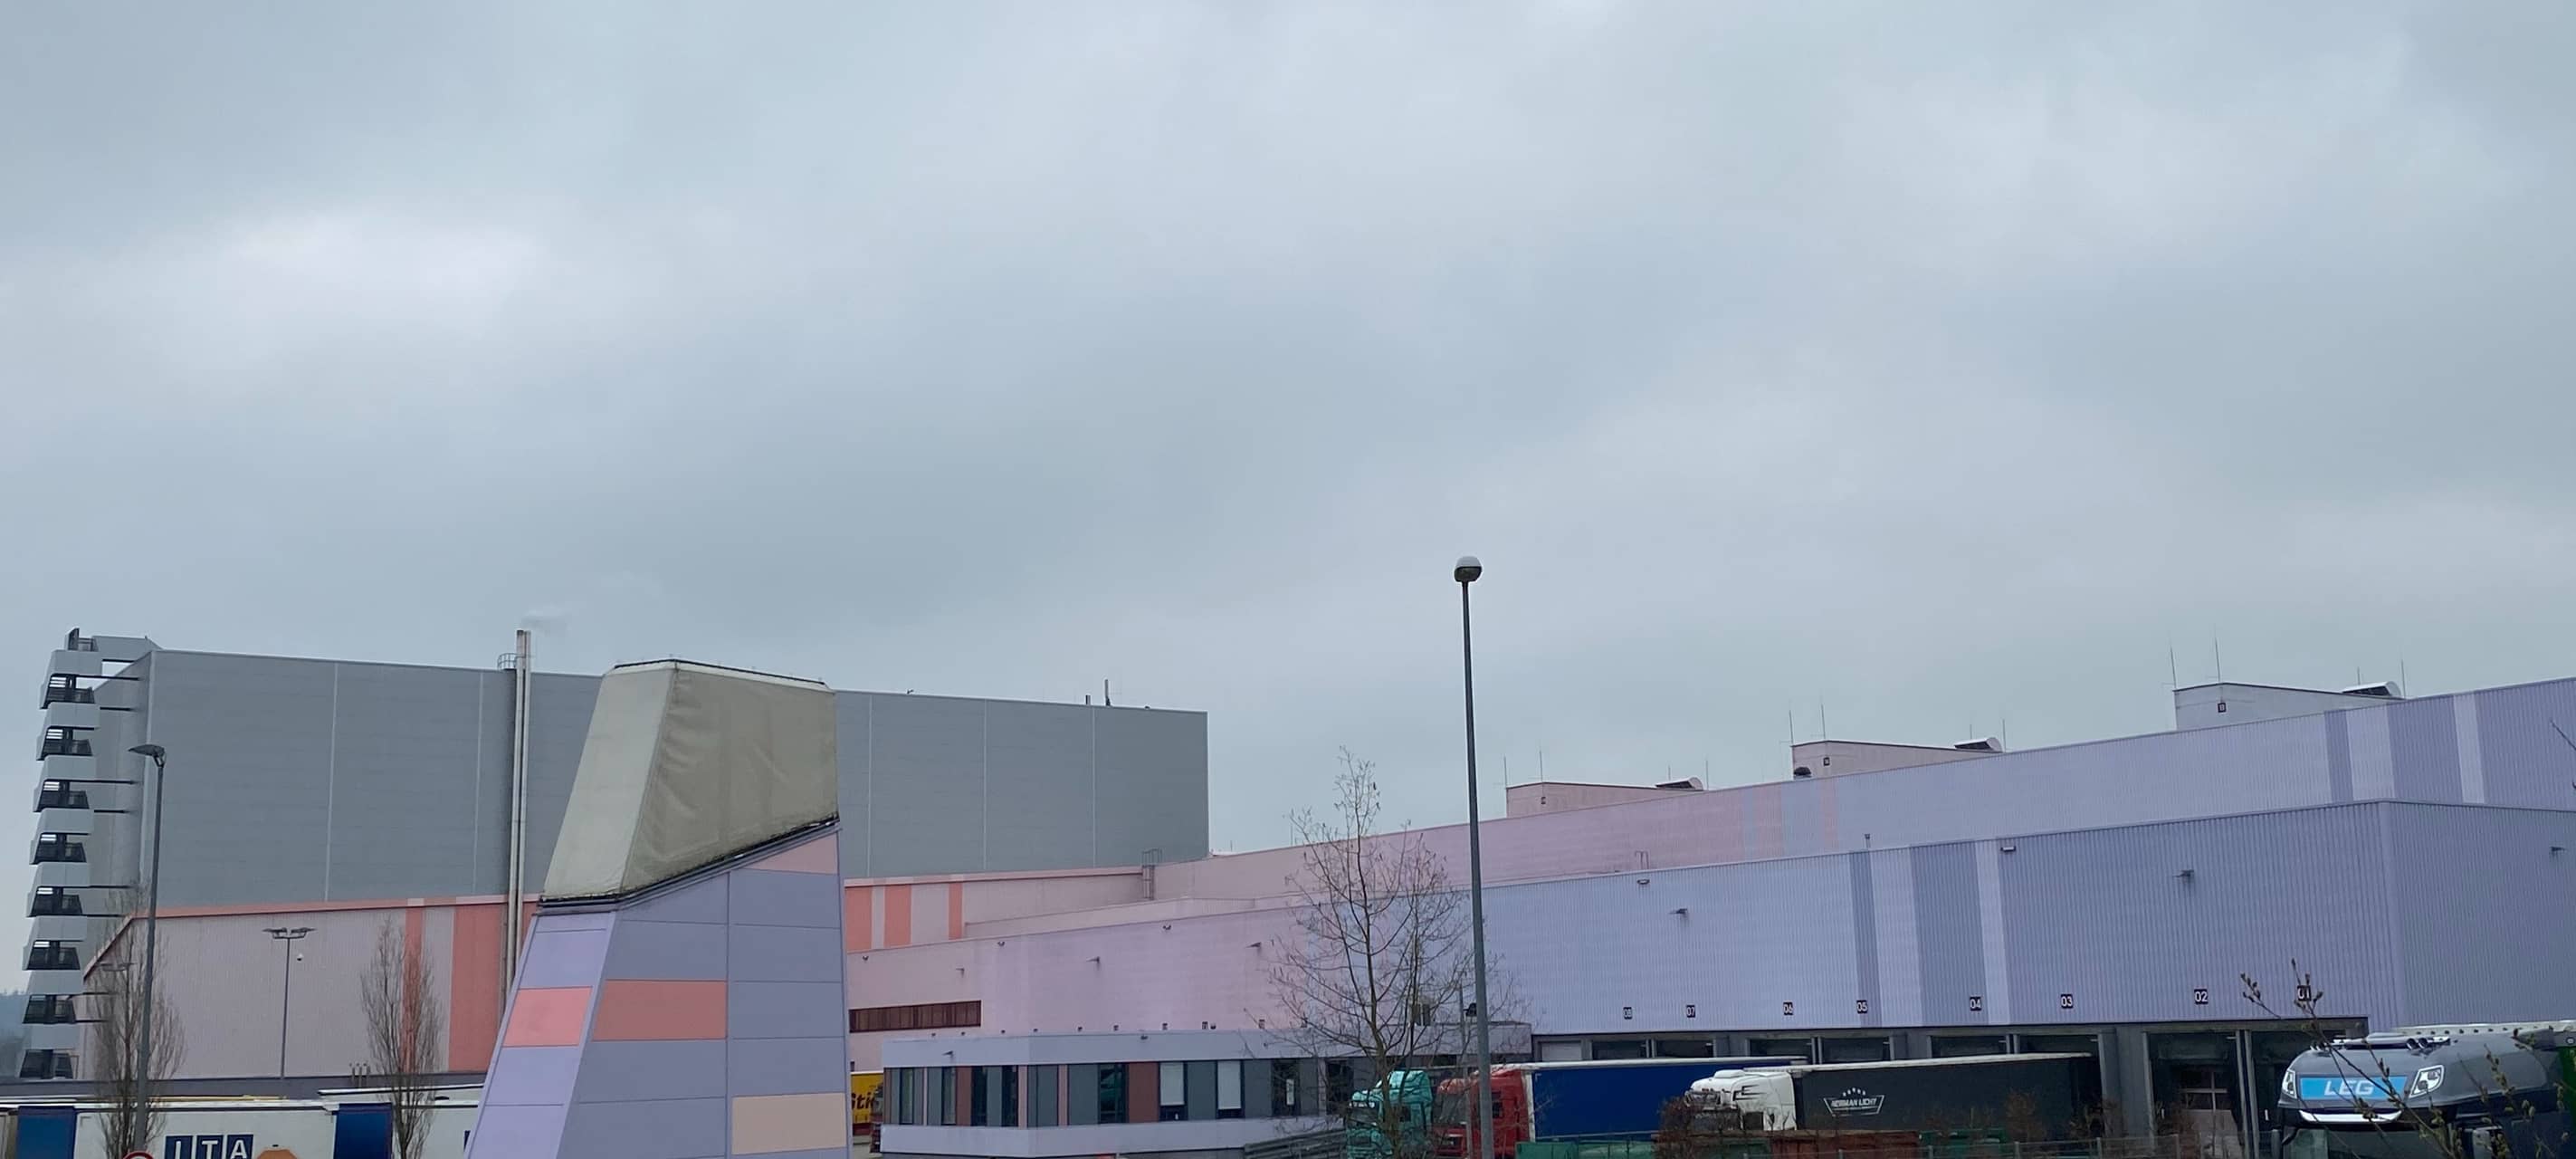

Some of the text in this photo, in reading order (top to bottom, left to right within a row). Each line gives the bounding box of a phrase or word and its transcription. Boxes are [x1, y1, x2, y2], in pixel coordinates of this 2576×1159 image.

[2061, 996, 2073, 1007] 03
[2195, 991, 2208, 1002] 02
[1783, 1004, 1794, 1014] 06
[1856, 1001, 1868, 1012] 05
[1970, 999, 1981, 1009] 04
[1686, 1006, 1695, 1016] 07
[2324, 1080, 2374, 1096] LEG
